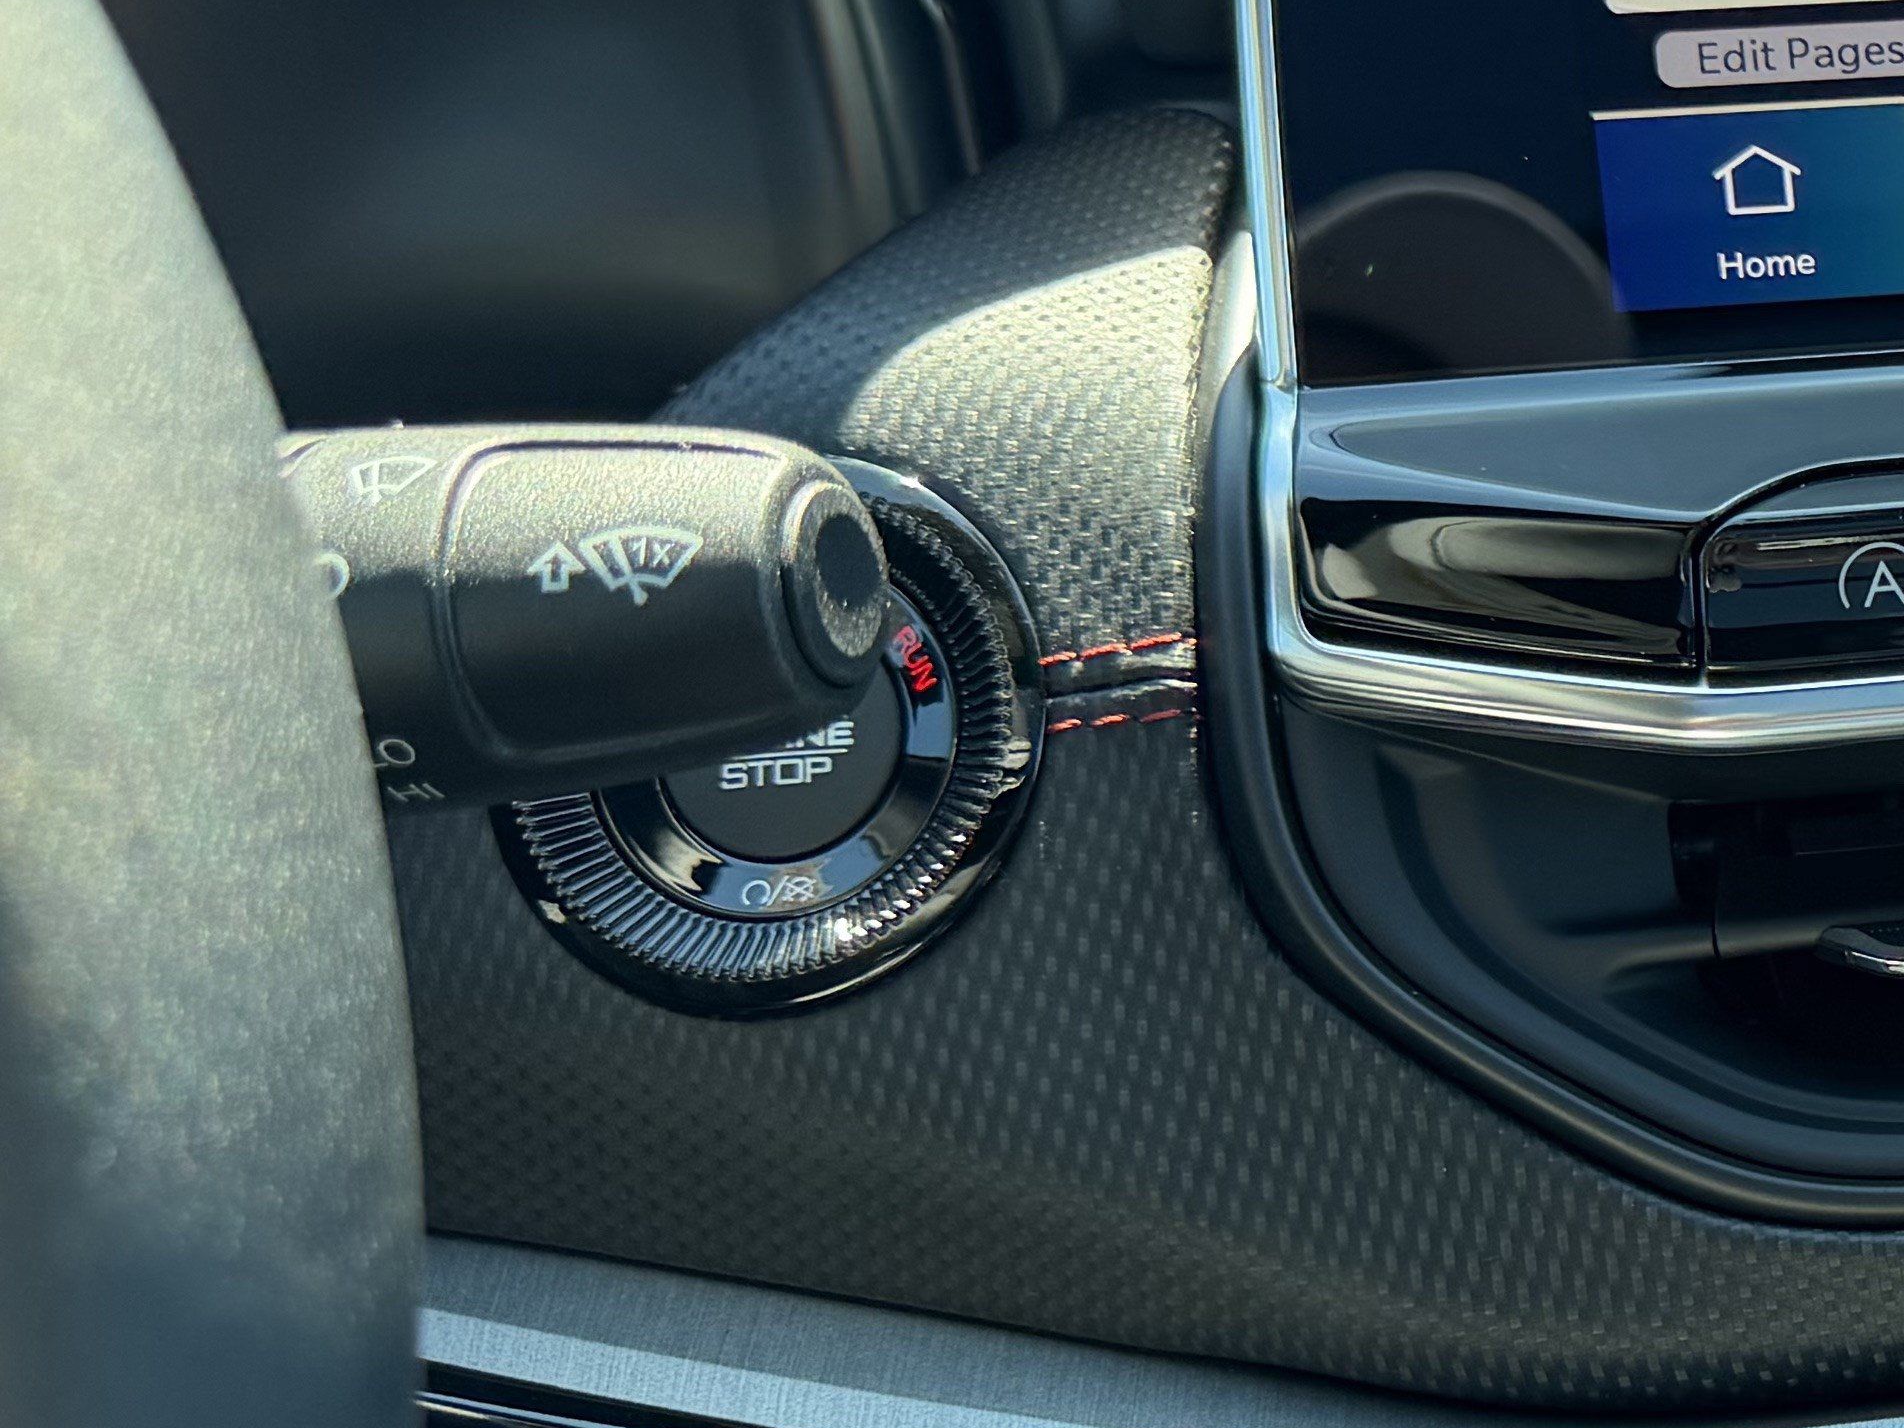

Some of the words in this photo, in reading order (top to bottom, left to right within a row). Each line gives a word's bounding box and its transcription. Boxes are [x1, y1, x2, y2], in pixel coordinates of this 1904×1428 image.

[1698, 40, 1775, 75] Edit
[1786, 37, 1904, 70] Pages
[1718, 249, 1815, 279] Home
[894, 627, 936, 693] RUN
[720, 756, 833, 790] STOP
